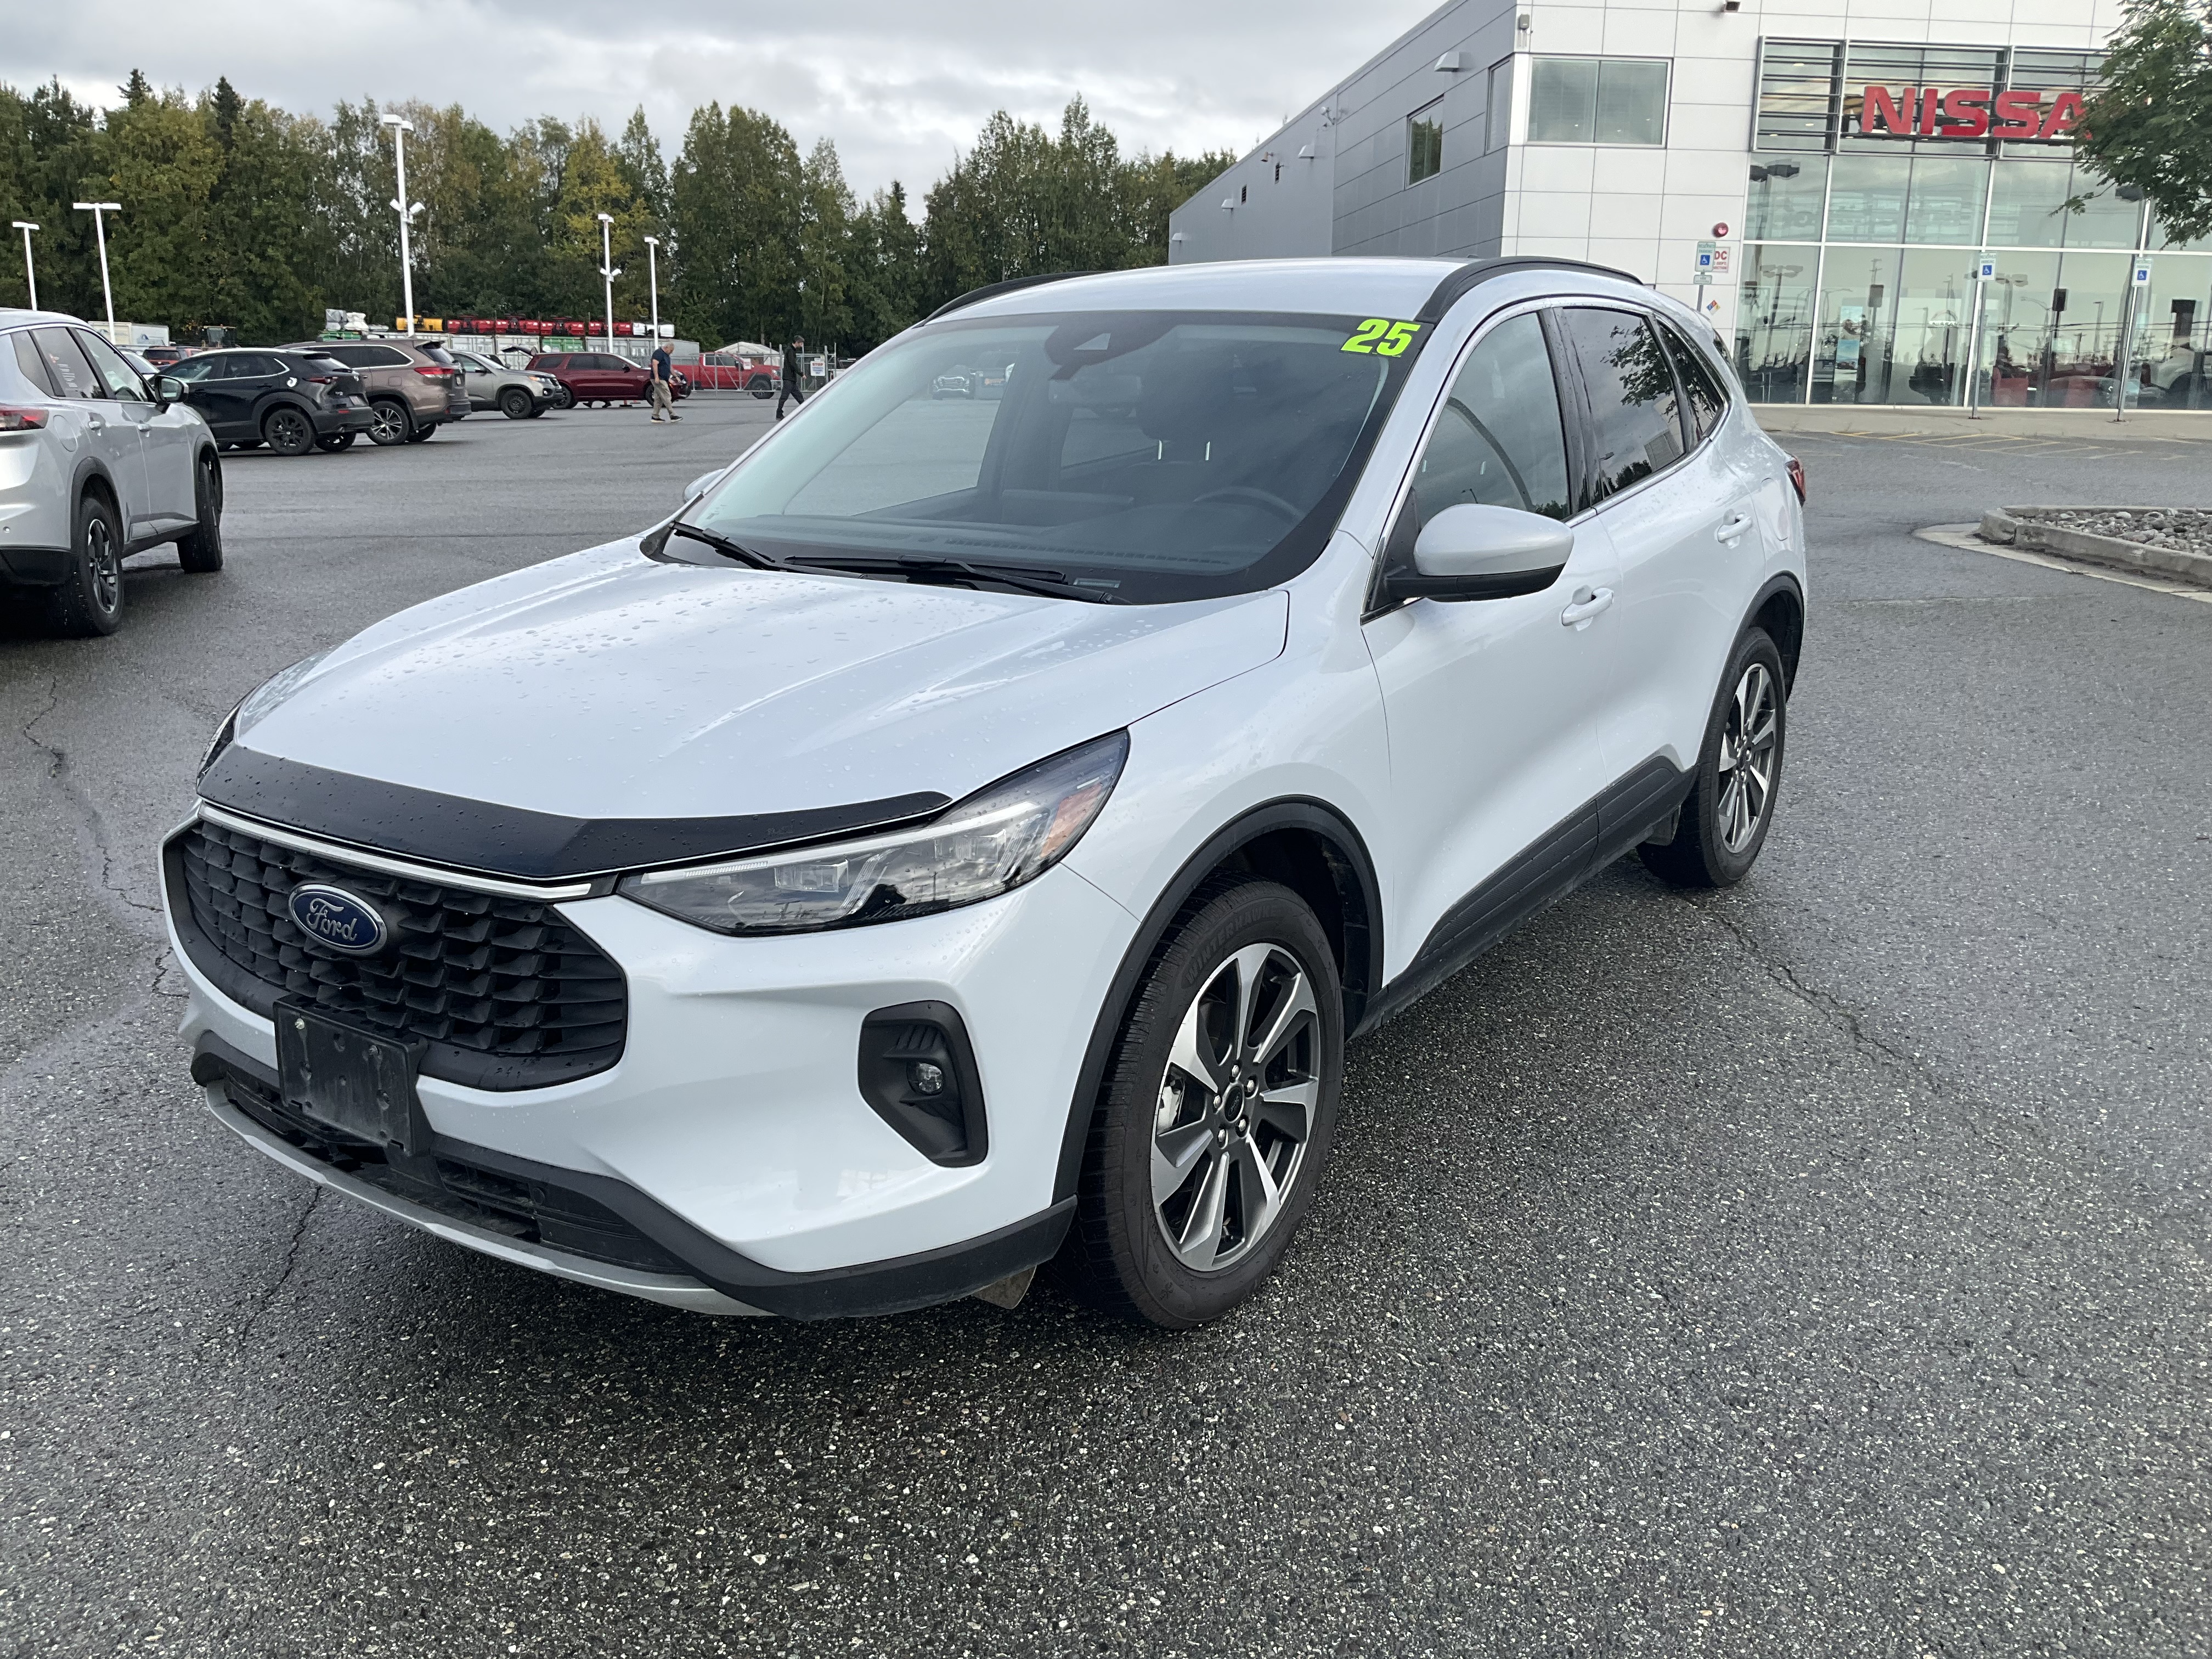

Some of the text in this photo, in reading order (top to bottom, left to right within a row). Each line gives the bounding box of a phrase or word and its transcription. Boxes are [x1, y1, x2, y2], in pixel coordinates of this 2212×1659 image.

[1861, 86, 2094, 140] NISSA
[1714, 251, 1727, 260] DC
[1340, 319, 1421, 356] 25
[306, 898, 358, 941] Ford
